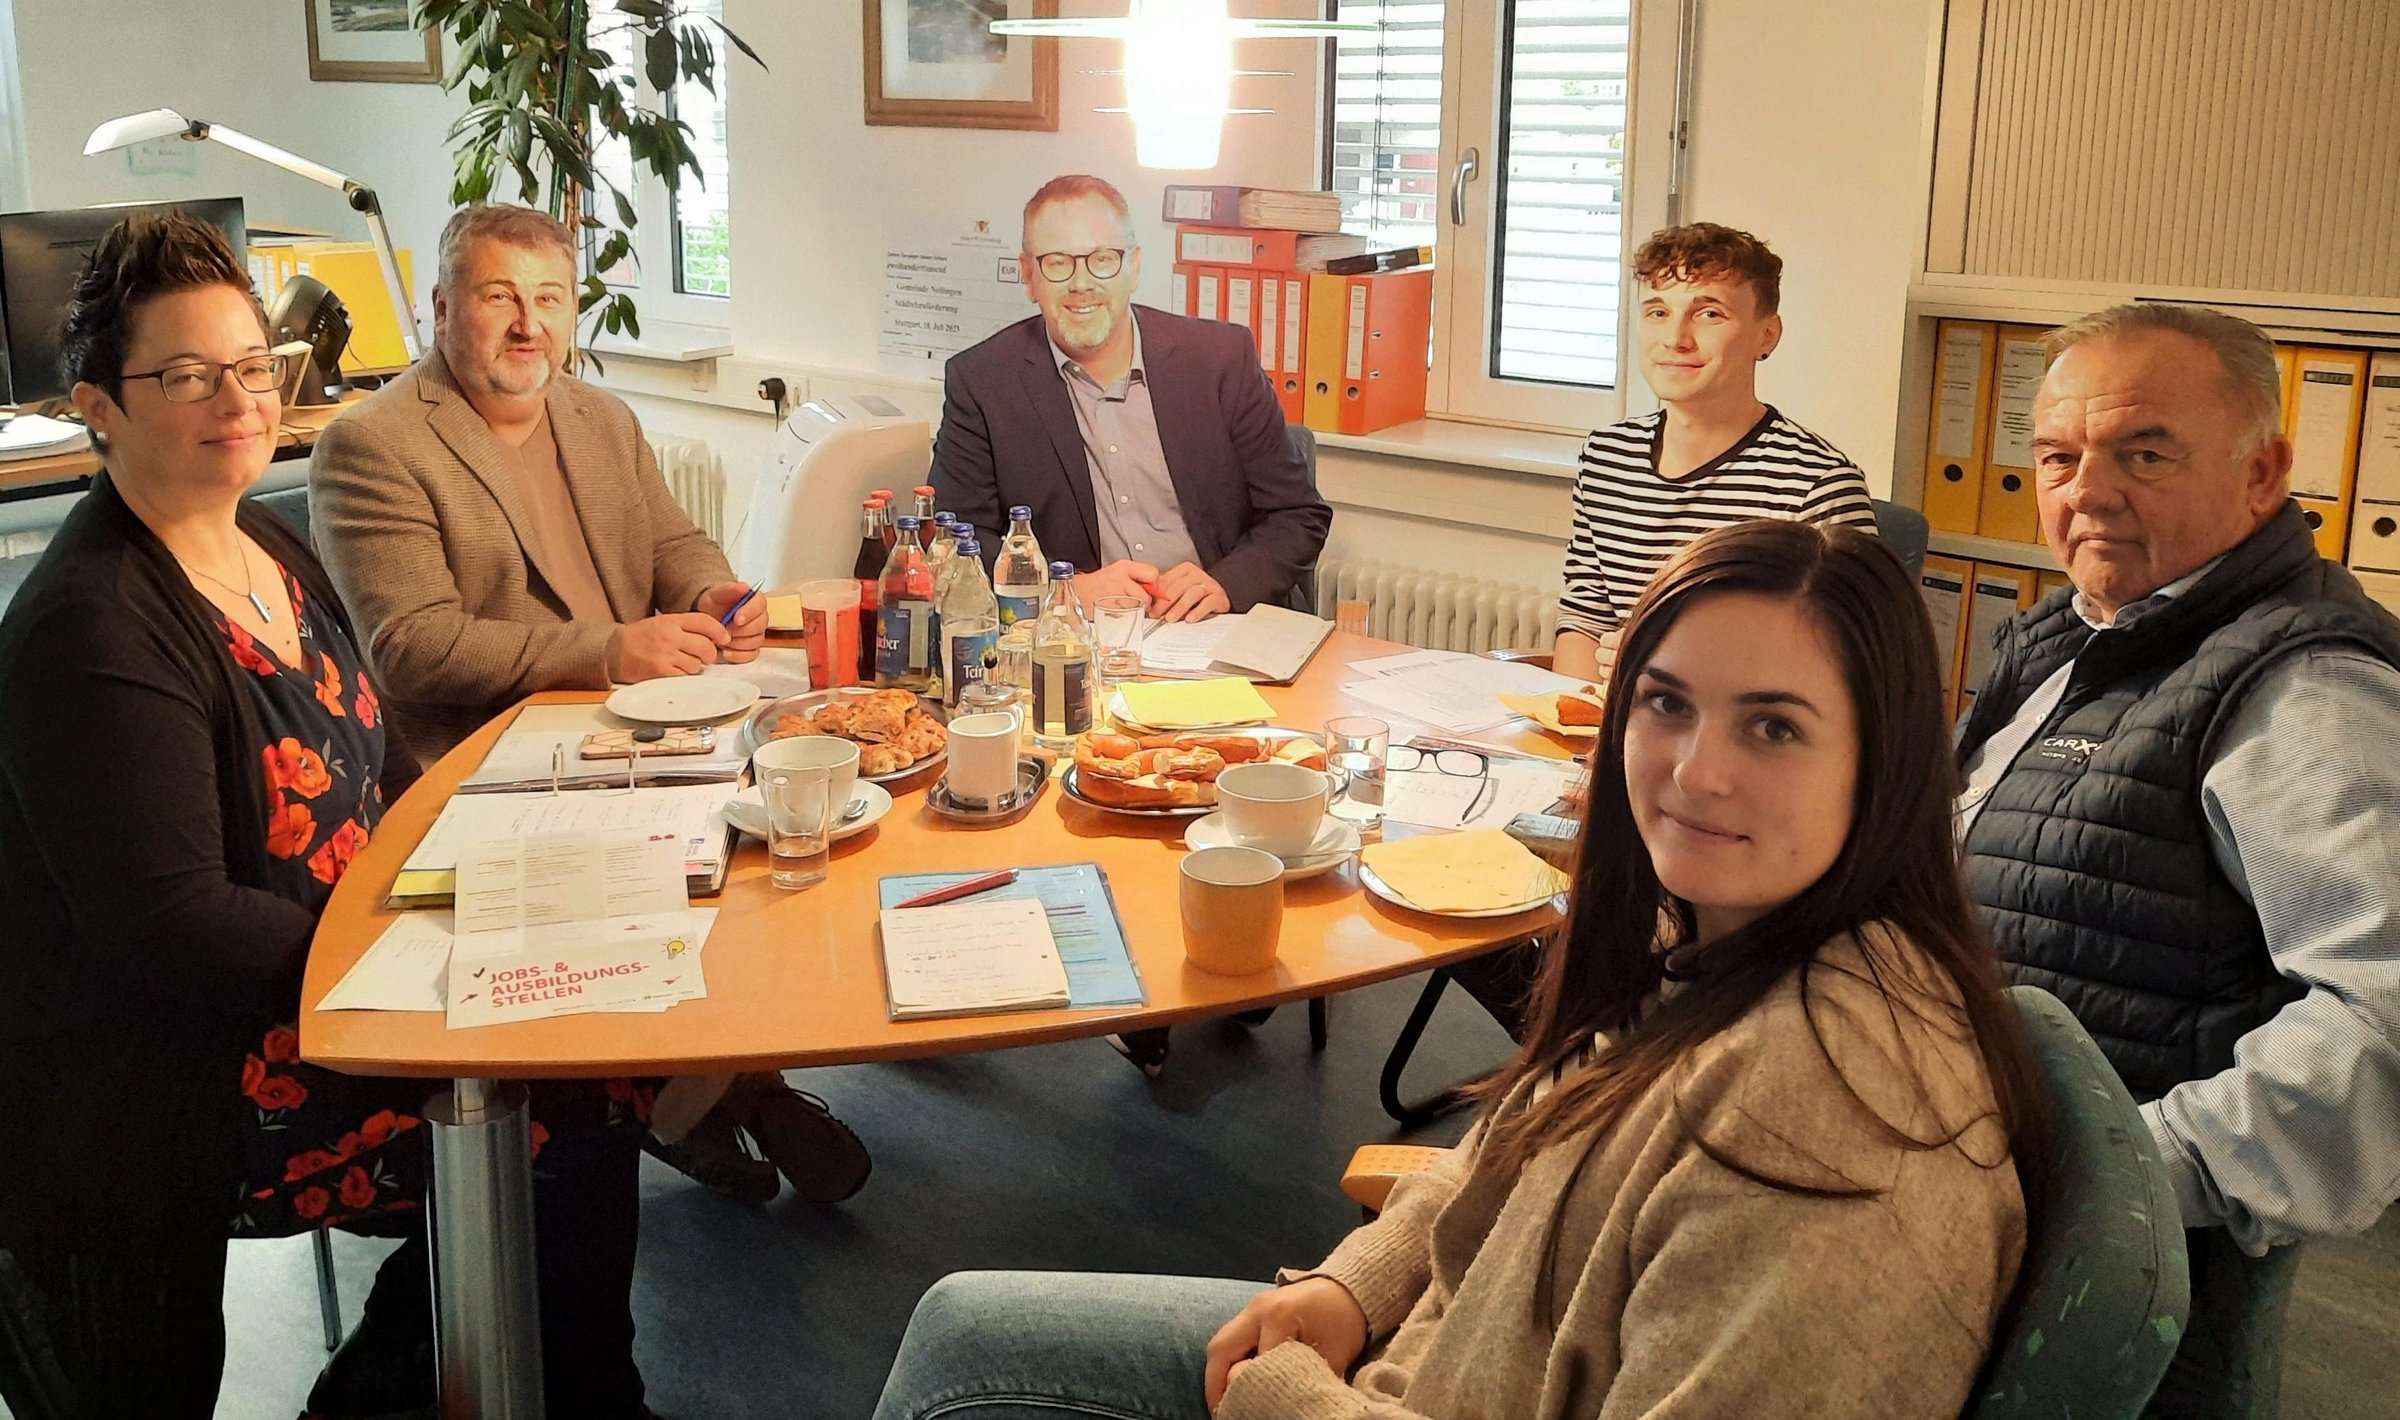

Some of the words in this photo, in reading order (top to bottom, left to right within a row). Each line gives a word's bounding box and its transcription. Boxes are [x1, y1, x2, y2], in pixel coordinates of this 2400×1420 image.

[1001, 265, 1017, 275] EUR
[488, 965, 548, 984] JOBS-
[554, 961, 568, 973] &
[490, 961, 650, 997] AUSBILDUNGS-
[492, 984, 583, 1008] STELLEN
